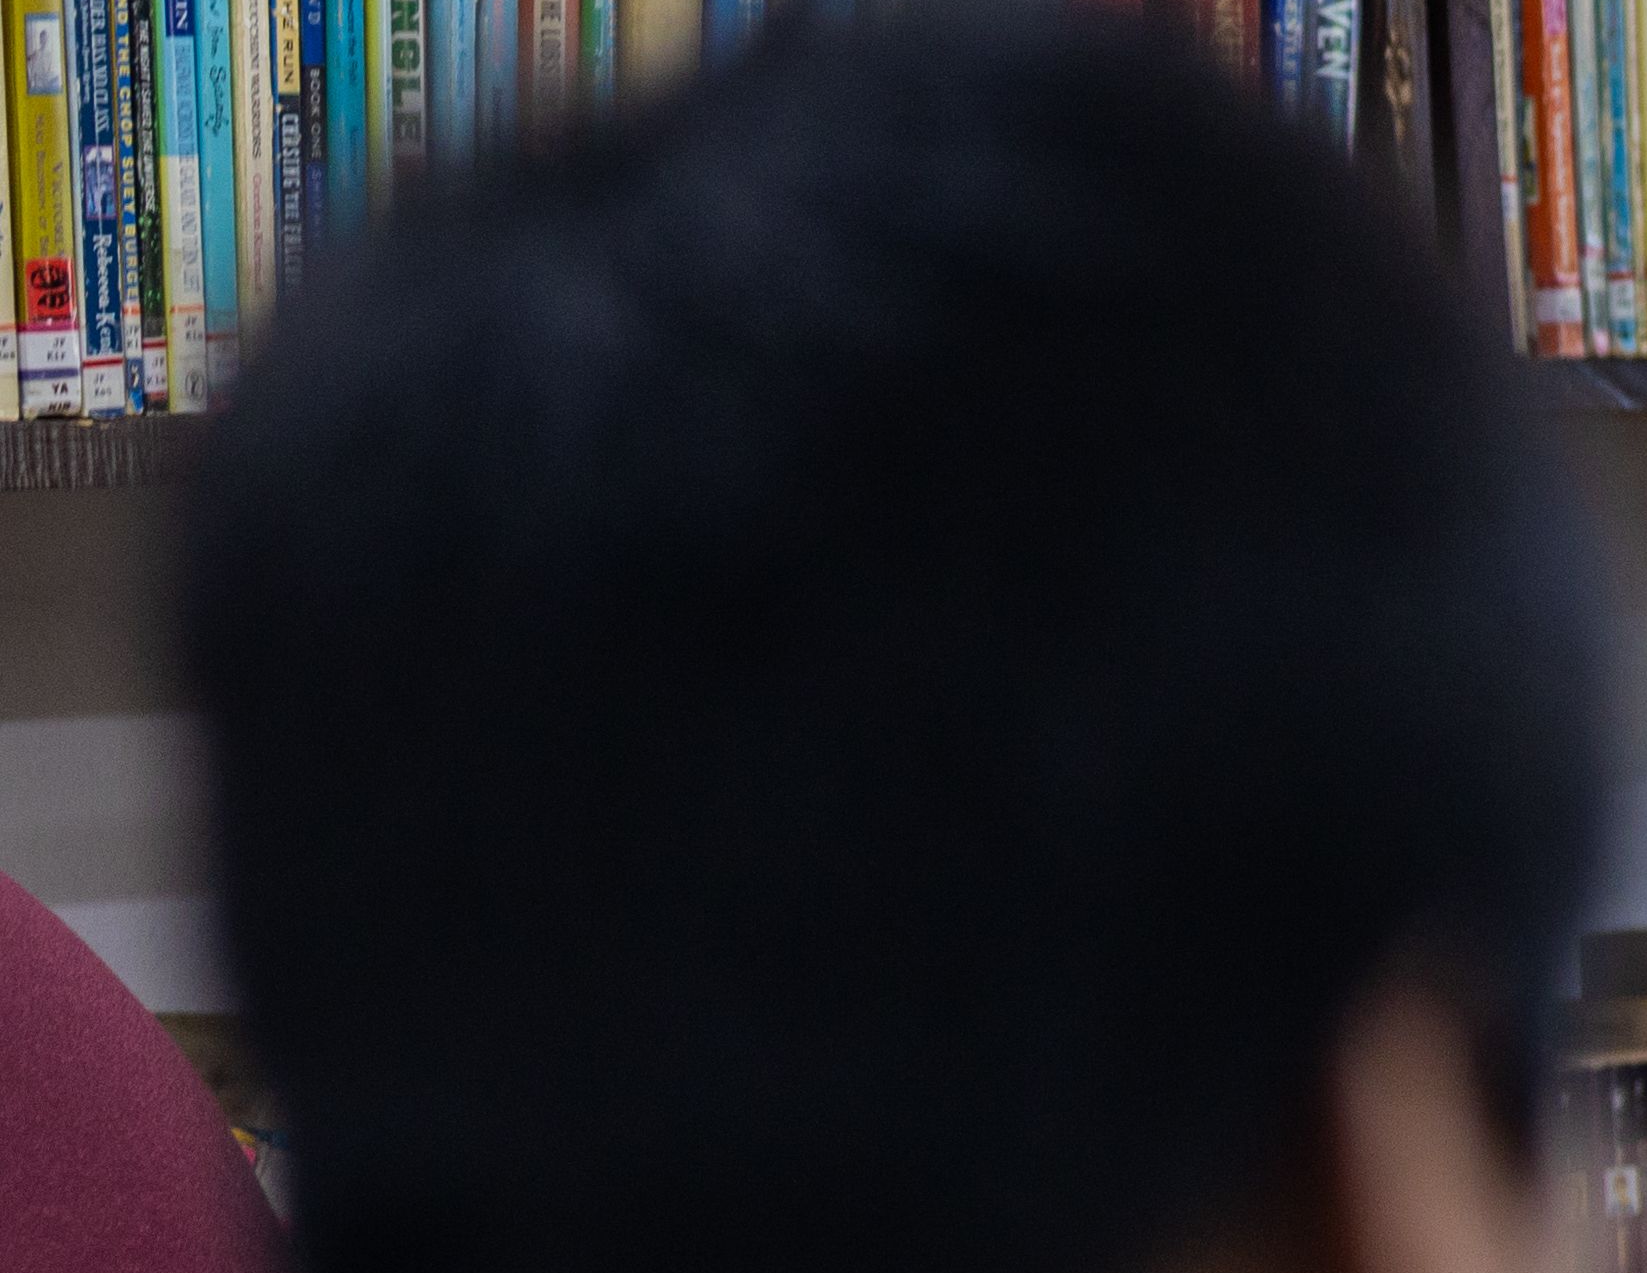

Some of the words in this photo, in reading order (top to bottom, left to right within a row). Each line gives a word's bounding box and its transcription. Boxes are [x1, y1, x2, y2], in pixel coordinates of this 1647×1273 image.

[117, 32, 130, 78] THE
[282, 40, 294, 84] RUN
[119, 87, 133, 147] CHOP
[309, 68, 321, 118] BOOK
[310, 122, 322, 158] ONE
[122, 155, 136, 216] SUEY
[124, 223, 139, 301] BURGE
[52, 383, 69, 394] YA
